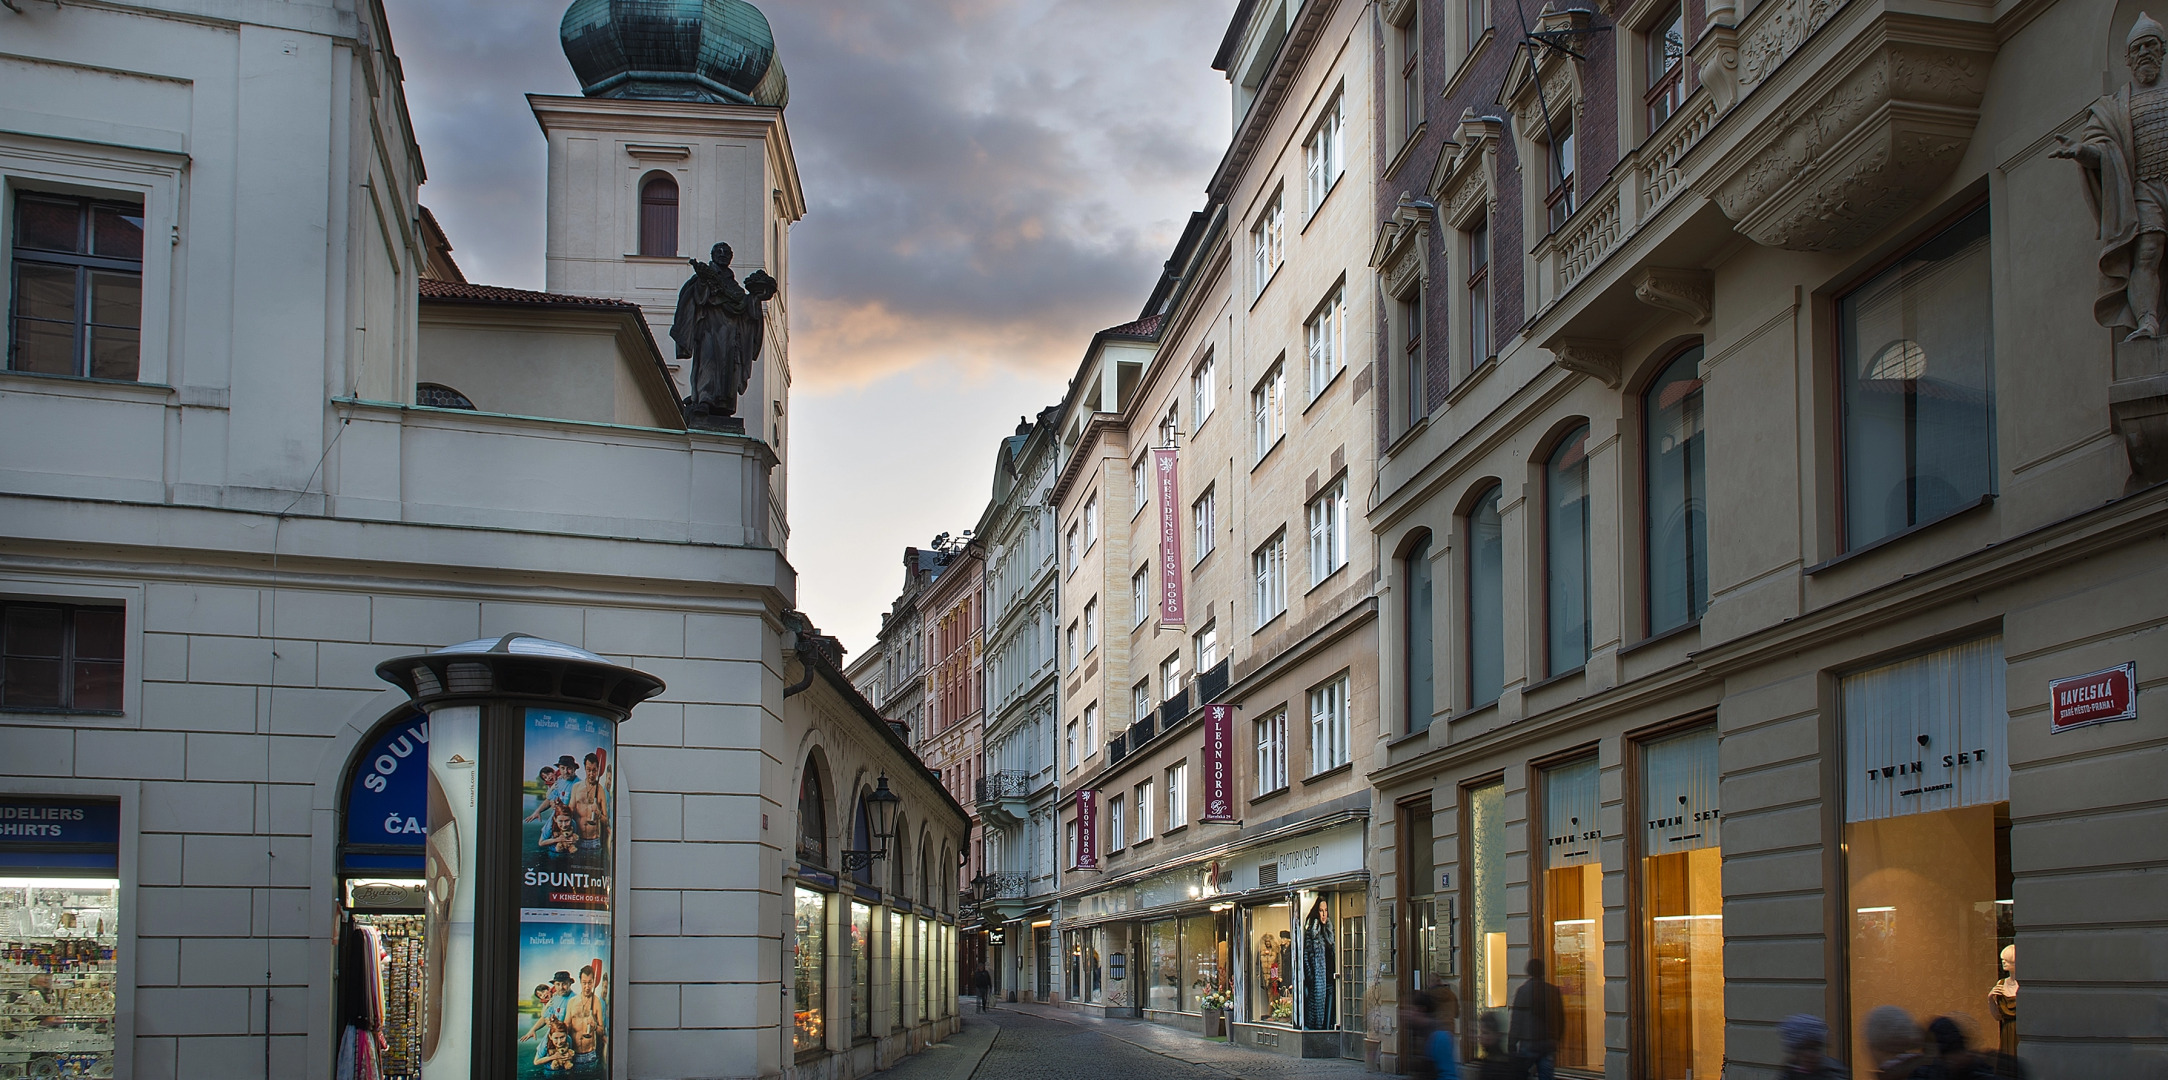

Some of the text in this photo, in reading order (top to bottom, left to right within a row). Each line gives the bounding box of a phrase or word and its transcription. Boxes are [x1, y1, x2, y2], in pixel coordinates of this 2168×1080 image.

[1163, 479, 1174, 542] RESIDENCE
[1166, 548, 1176, 576] LEON
[2060, 678, 2112, 706] HAVELSKÁ
[2060, 705, 2074, 718] STARÉ
[2110, 699, 2115, 708] 1
[1215, 722, 1223, 759] LEON
[1867, 749, 1986, 780] TWIN SET
[0, 807, 84, 821] DELIERS
[1648, 809, 1720, 829] TWIN SET
[1548, 834, 1575, 846] TWIN
[1280, 845, 1320, 871] FACTORY SHOP
[524, 867, 590, 888] ŠPUNTI
[590, 878, 602, 888] na
[358, 887, 403, 900] Bydžov
